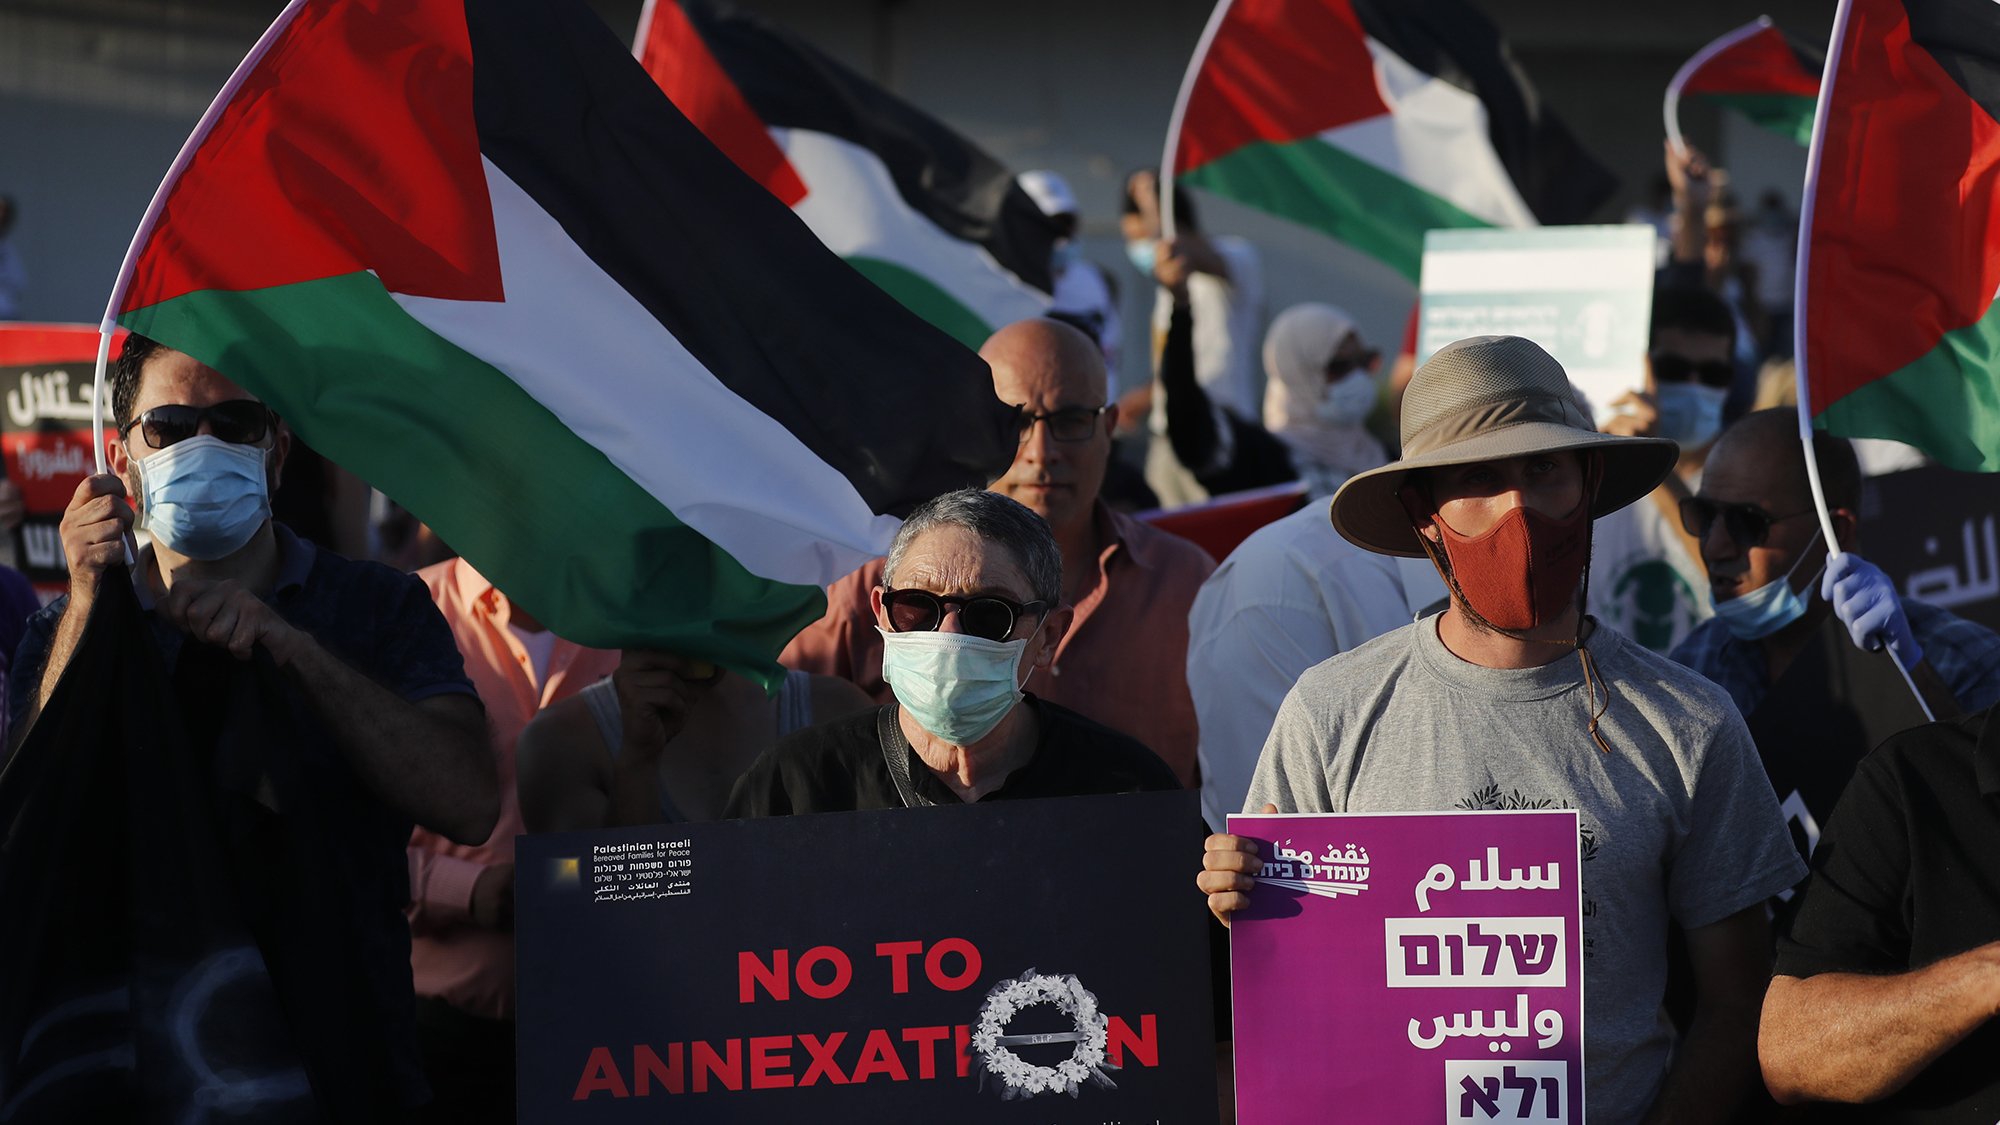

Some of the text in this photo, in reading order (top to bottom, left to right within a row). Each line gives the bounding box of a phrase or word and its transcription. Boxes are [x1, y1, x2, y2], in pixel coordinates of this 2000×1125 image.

[593, 839, 691, 854] Palestinian Israeli
[593, 848, 691, 862] Bereaved Families for Peace
[1319, 843, 1370, 865] نقف
[594, 859, 691, 873] פורום משפחות שכולות
[616, 873, 632, 881] בעד
[1253, 862, 1370, 882] עומדים ביח
[594, 874, 613, 883] שלום
[1414, 847, 1560, 912] سلام
[1399, 923, 1558, 976] שלום
[738, 938, 982, 1003] NO TO
[1407, 994, 1564, 1053] وليس
[572, 1013, 1160, 1100] ANNEXATIN
[1459, 1066, 1560, 1119] ולא
